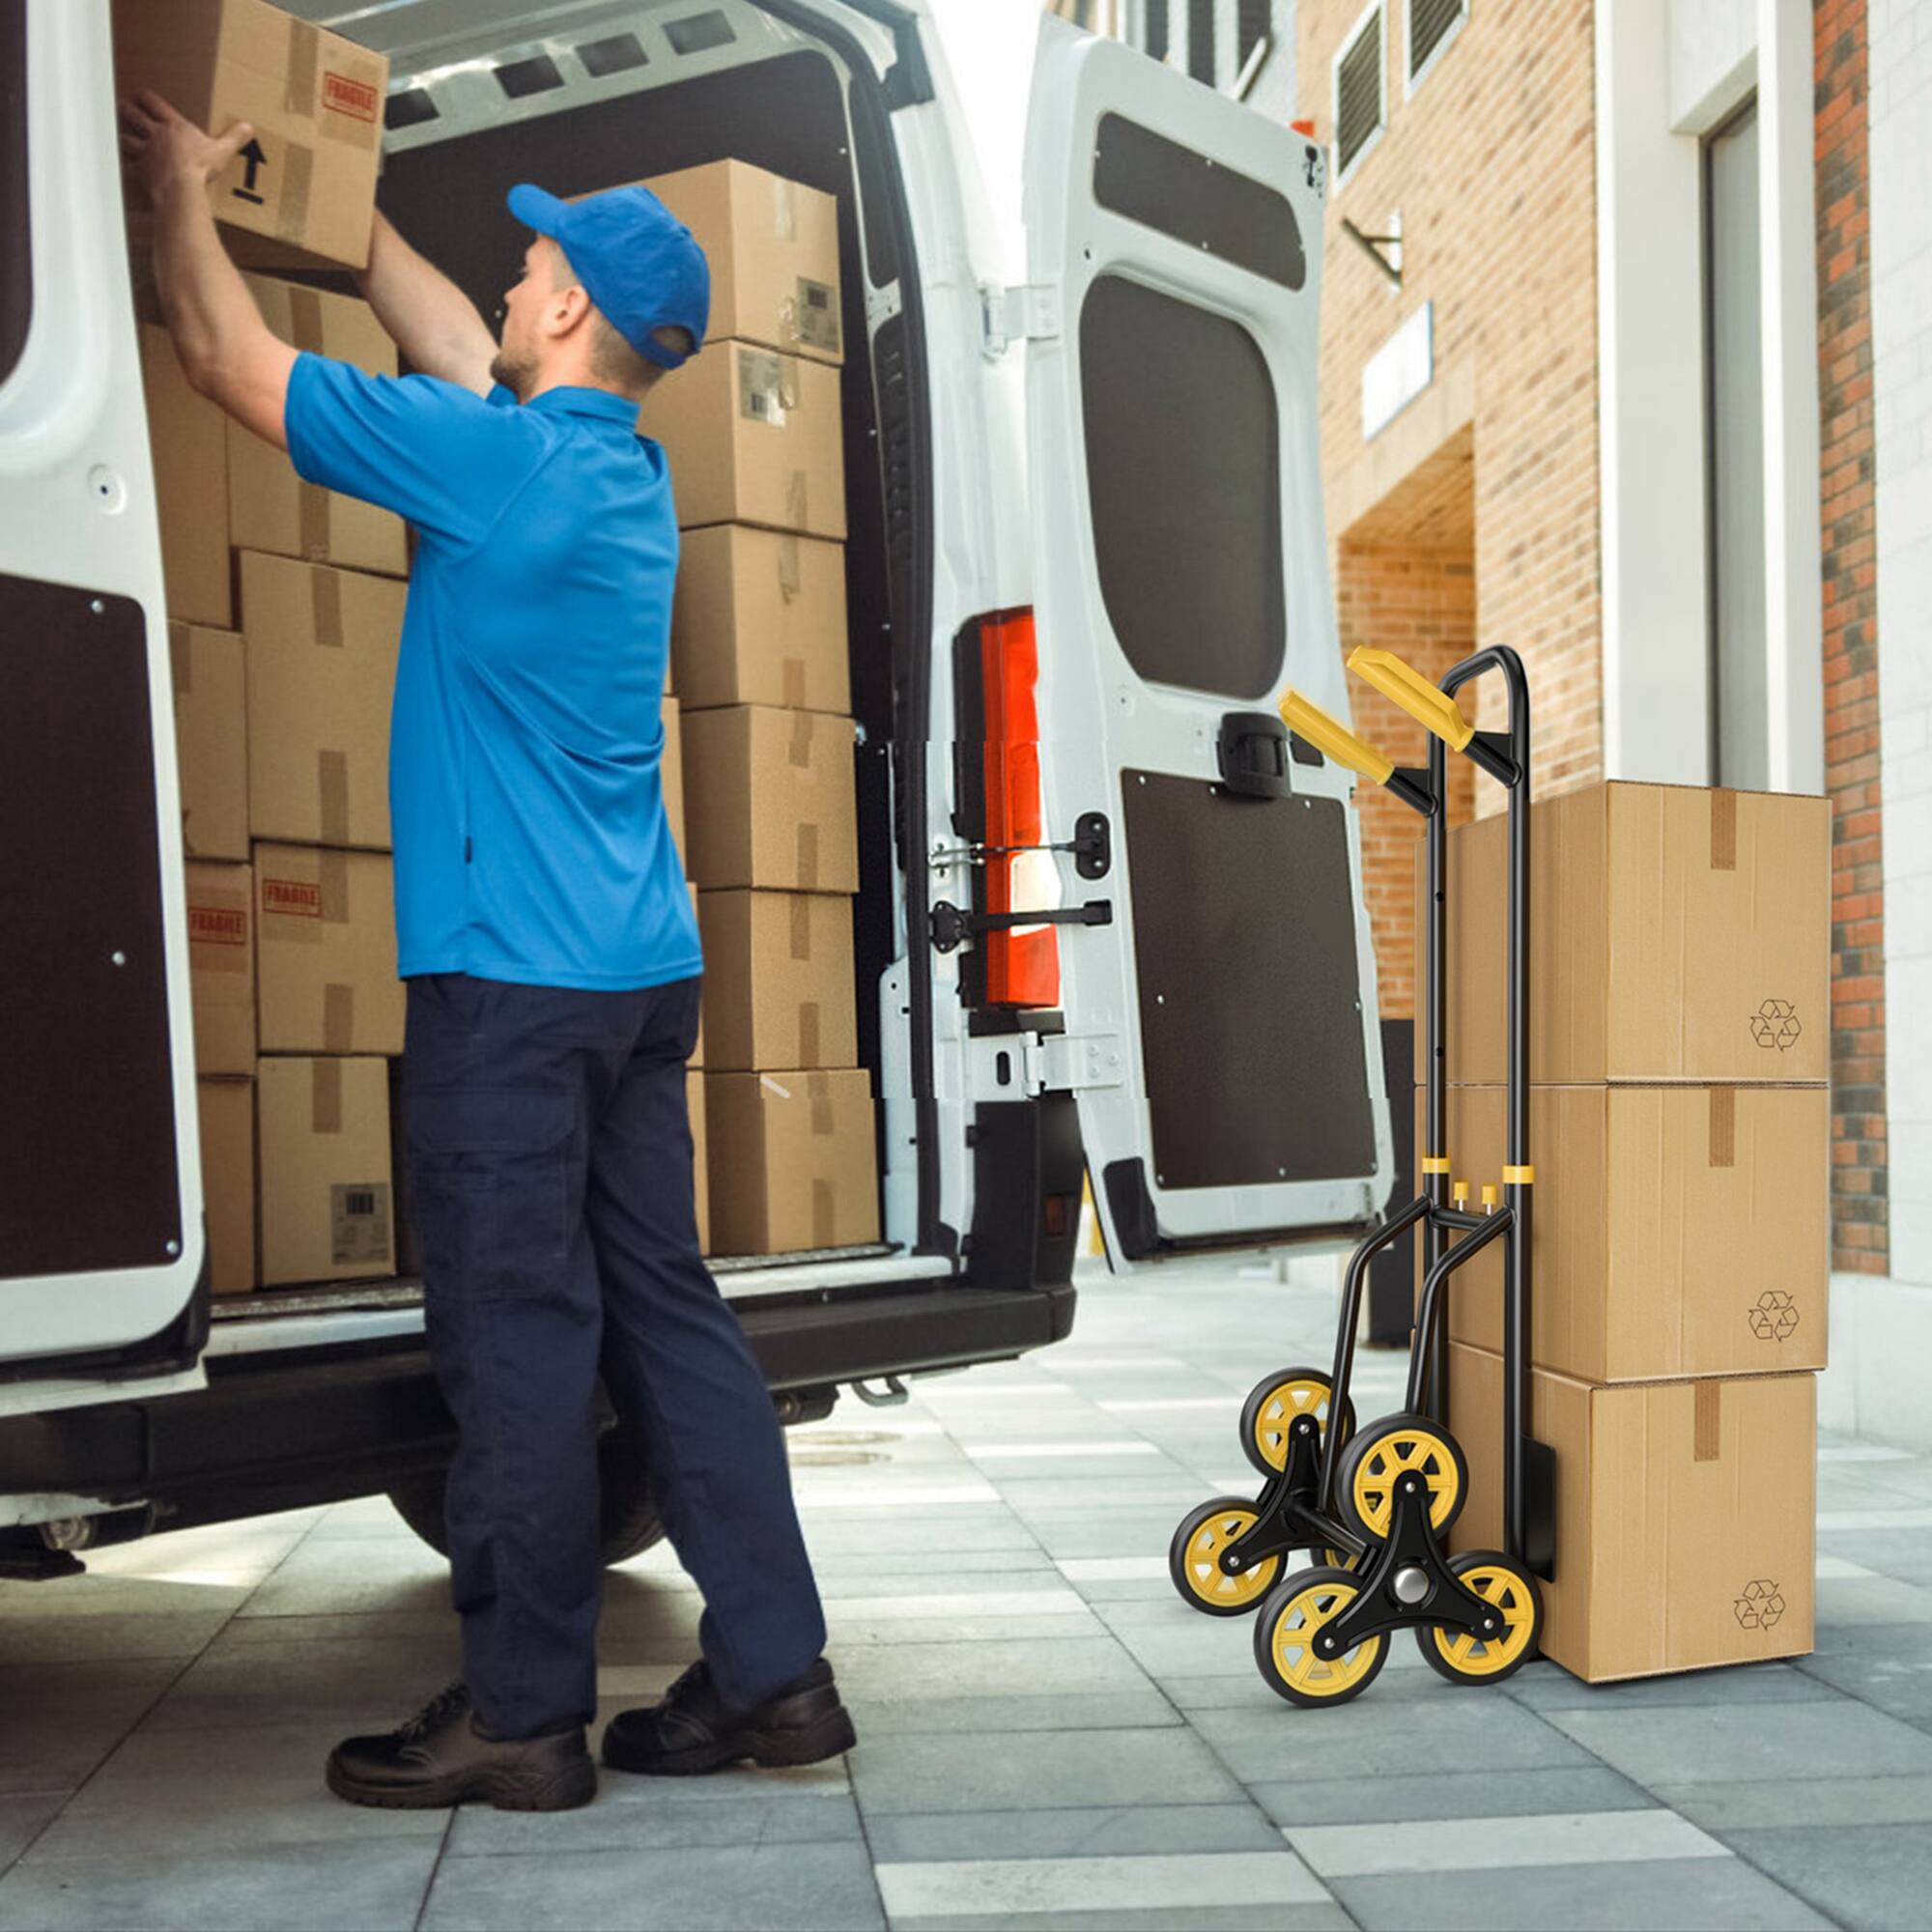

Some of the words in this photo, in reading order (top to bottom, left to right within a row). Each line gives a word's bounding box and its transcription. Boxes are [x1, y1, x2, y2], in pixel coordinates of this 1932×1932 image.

[327, 78, 373, 111] FRAGILE
[267, 885, 316, 906] FRAGILE
[190, 912, 242, 934] FRAGILE
